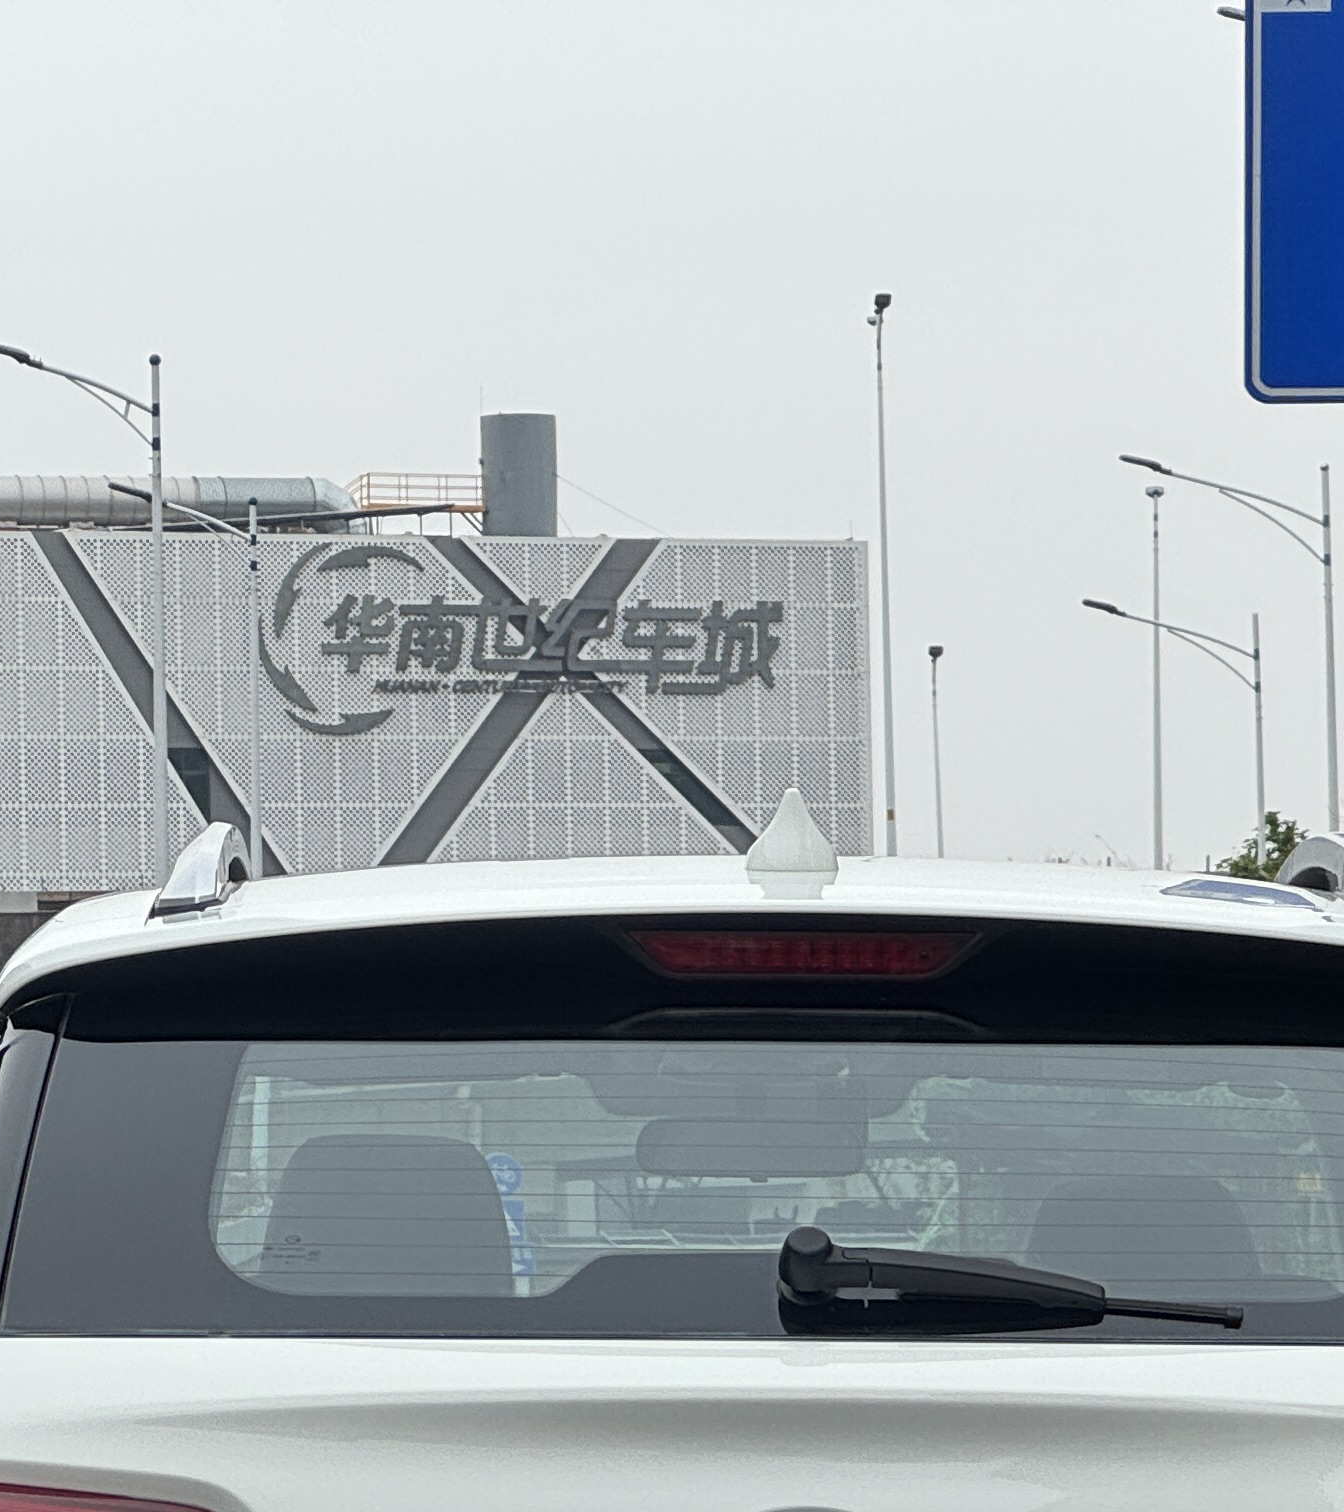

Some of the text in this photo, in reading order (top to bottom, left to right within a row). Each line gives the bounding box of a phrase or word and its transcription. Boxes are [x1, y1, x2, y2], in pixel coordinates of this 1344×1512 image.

[320, 594, 786, 696] 华南世纪车城
